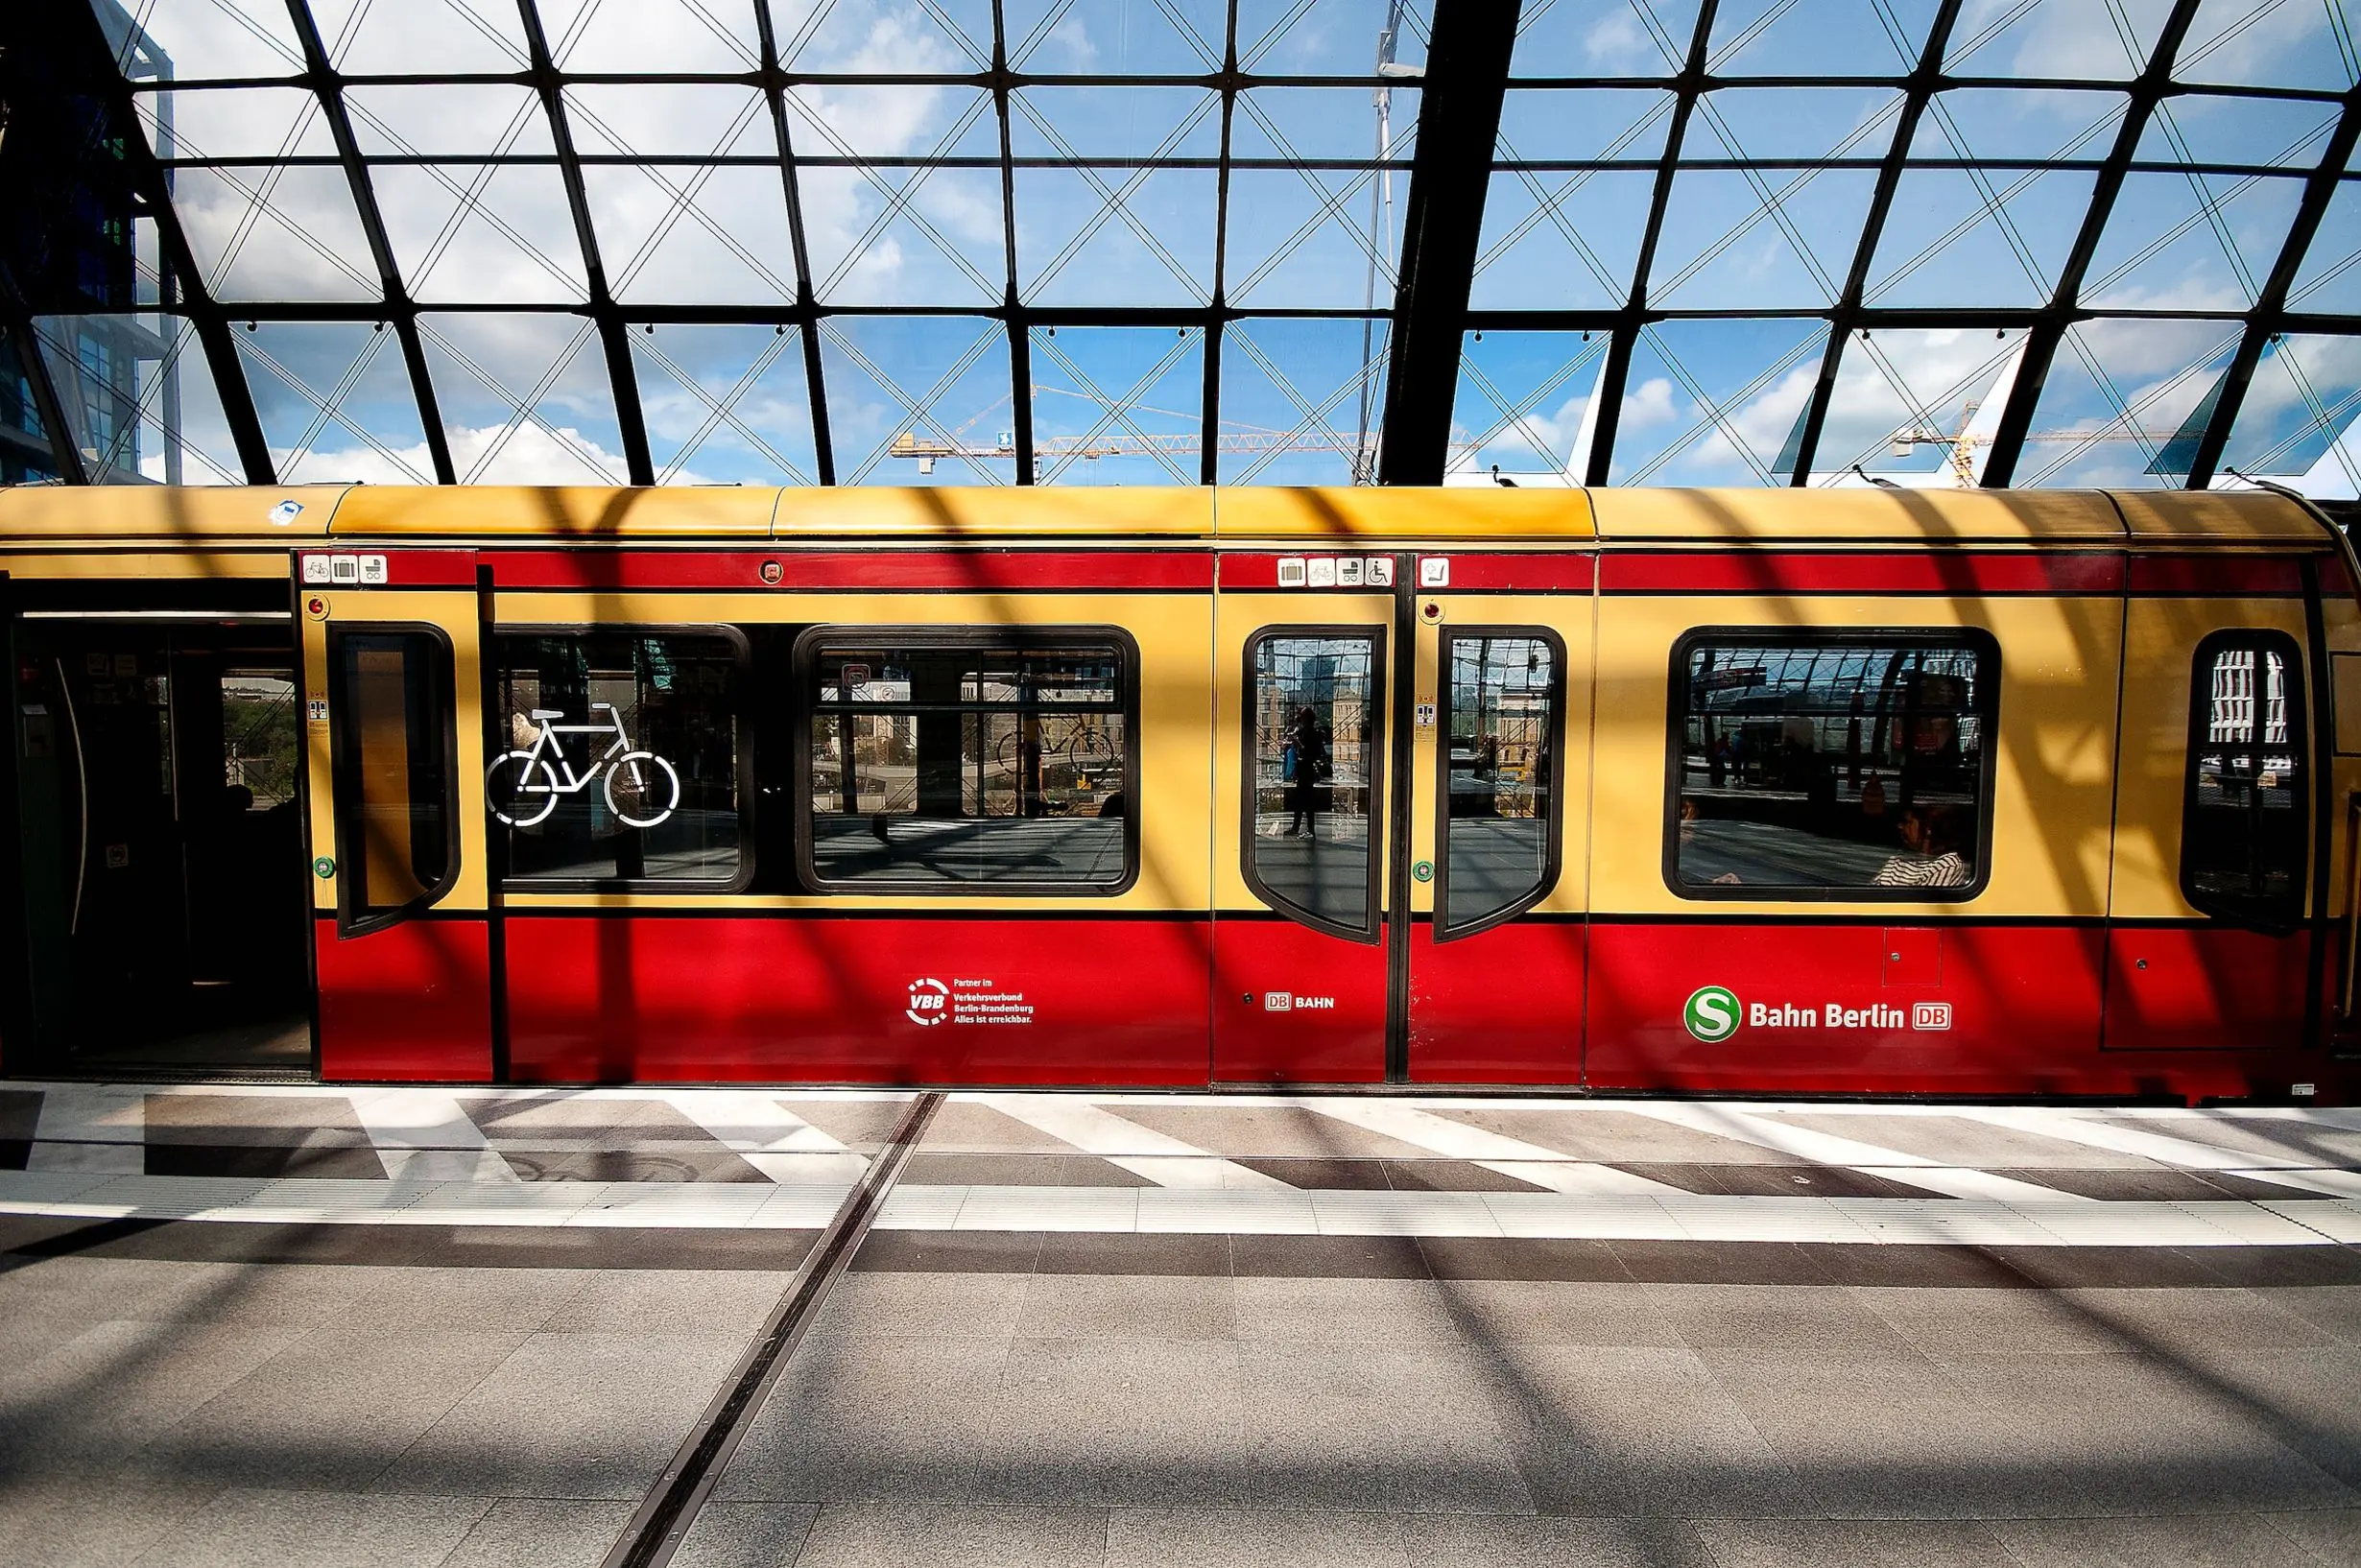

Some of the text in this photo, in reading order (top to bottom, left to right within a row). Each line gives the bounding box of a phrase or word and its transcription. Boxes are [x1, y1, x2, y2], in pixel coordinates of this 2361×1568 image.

[910, 994, 945, 1010] VBB
[953, 993, 1023, 1002] Verkehrsverbund
[1268, 994, 1334, 1009] DB BAHN
[954, 1004, 1034, 1014] Berlin-Brandenburg
[1693, 991, 1947, 1037] S Bahn Berlin DB
[954, 1015, 1033, 1024] Alles ist erreichbar.
